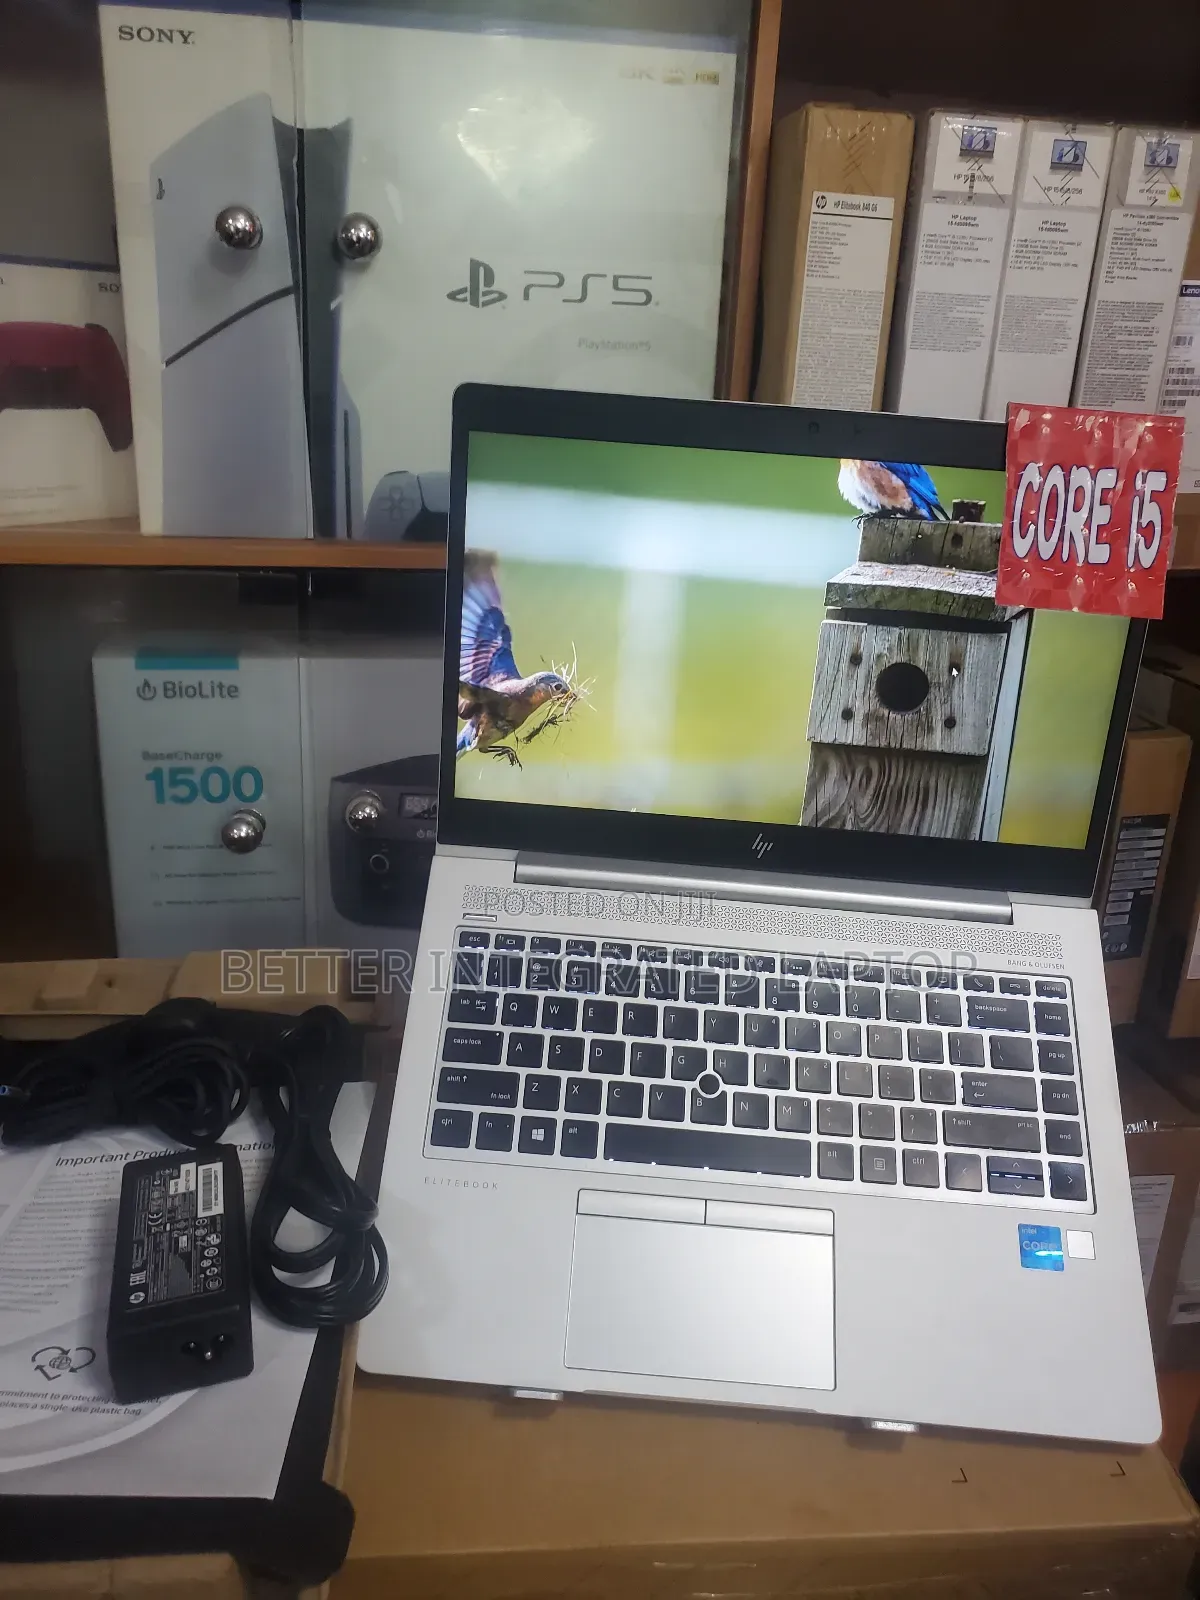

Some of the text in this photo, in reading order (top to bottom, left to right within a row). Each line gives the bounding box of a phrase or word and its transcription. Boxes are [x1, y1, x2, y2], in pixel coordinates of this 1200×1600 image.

[118, 24, 194, 45] SONY
[833, 200, 841, 209] HP
[862, 203, 871, 212] 840
[1050, 220, 1067, 228] Laptop
[522, 269, 653, 307] PS5
[1011, 461, 1168, 570] CORE i5
[163, 680, 239, 699] BioLite
[142, 750, 223, 762] BaseCharge
[145, 765, 264, 805] 1500
[532, 962, 541, 971] @
[1007, 959, 1027, 967] BANG
[1034, 961, 1065, 970] OLUFSEN
[532, 974, 538, 983] 2
[571, 976, 577, 986] 3
[610, 980, 617, 989] 4
[650, 983, 656, 993] 5
[689, 986, 696, 995] 6
[730, 991, 737, 1000] 7
[460, 997, 471, 1005] tab
[771, 995, 778, 1005] 8
[812, 1000, 819, 1009] 9
[509, 1001, 518, 1012] Q
[549, 1004, 560, 1015] W
[852, 1003, 859, 1012] 0
[974, 1003, 1008, 1013] backspace
[588, 1007, 594, 1017] E
[628, 1010, 635, 1021] R
[1044, 1013, 1062, 1021] home
[669, 1013, 676, 1023] T
[710, 1018, 717, 1028] Y
[751, 1021, 759, 1032] U
[833, 1030, 842, 1040] O
[874, 1033, 880, 1043] P
[515, 1042, 523, 1052] A
[555, 1044, 562, 1054] S
[595, 1047, 603, 1057] D
[636, 1051, 643, 1061] F
[677, 1055, 685, 1065] G
[1048, 1051, 1057, 1059] pg
[719, 1058, 727, 1068] H
[762, 1063, 767, 1073] J
[803, 1067, 810, 1077] K
[844, 1070, 850, 1080] L
[446, 1075, 461, 1083] shift
[971, 1080, 988, 1088] enter
[531, 1081, 539, 1092] Z
[572, 1084, 580, 1095] X
[613, 1088, 621, 1098] C
[655, 1091, 664, 1101] V
[1052, 1092, 1061, 1100] pg
[696, 1097, 703, 1107] B
[740, 1101, 749, 1111] N
[782, 1105, 792, 1116] M
[441, 1117, 453, 1127] ctrl
[485, 1120, 493, 1129] fn
[958, 1119, 972, 1127] shift
[568, 1126, 578, 1134] alt
[1059, 1133, 1072, 1141] end
[55, 1151, 131, 1167] Important
[827, 1150, 838, 1158] alt
[912, 1157, 926, 1165] ctrl
[424, 1176, 499, 1190] ELITEBOOK
[1021, 1227, 1037, 1235] intel
[50, 1392, 61, 1400] to
[90, 1406, 121, 1416] plastic
[123, 1407, 142, 1417] bag
